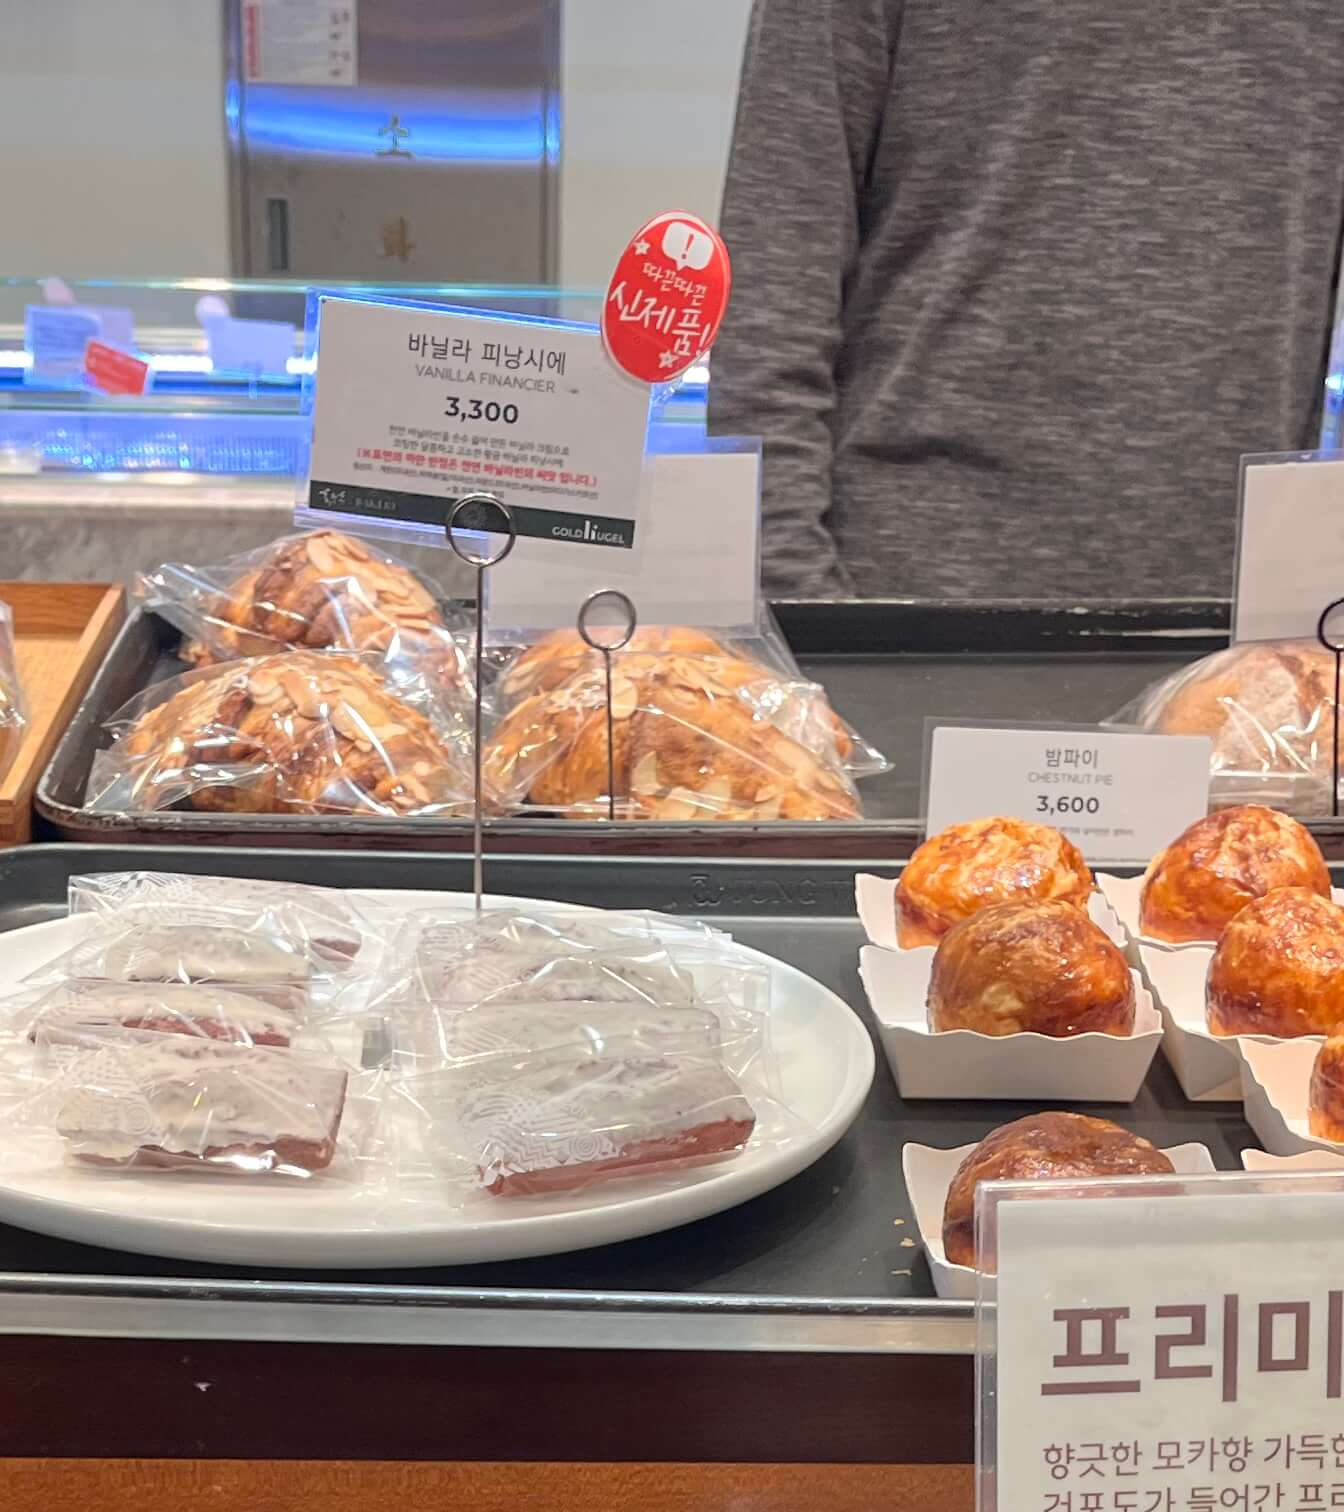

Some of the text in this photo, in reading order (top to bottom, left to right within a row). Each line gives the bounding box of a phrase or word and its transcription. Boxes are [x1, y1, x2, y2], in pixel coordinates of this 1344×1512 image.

[408, 332, 567, 376] 바닐라 피낭시에
[415, 364, 555, 394] VANILLA FINANCIER
[444, 396, 519, 424] 3,300
[1044, 748, 1099, 769] 밤파이
[1027, 771, 1092, 785] CHESTNUT
[1036, 795, 1100, 815] 3,600
[1043, 1440, 1143, 1480] 향긋한
[1152, 1436, 1253, 1473] 모카향
